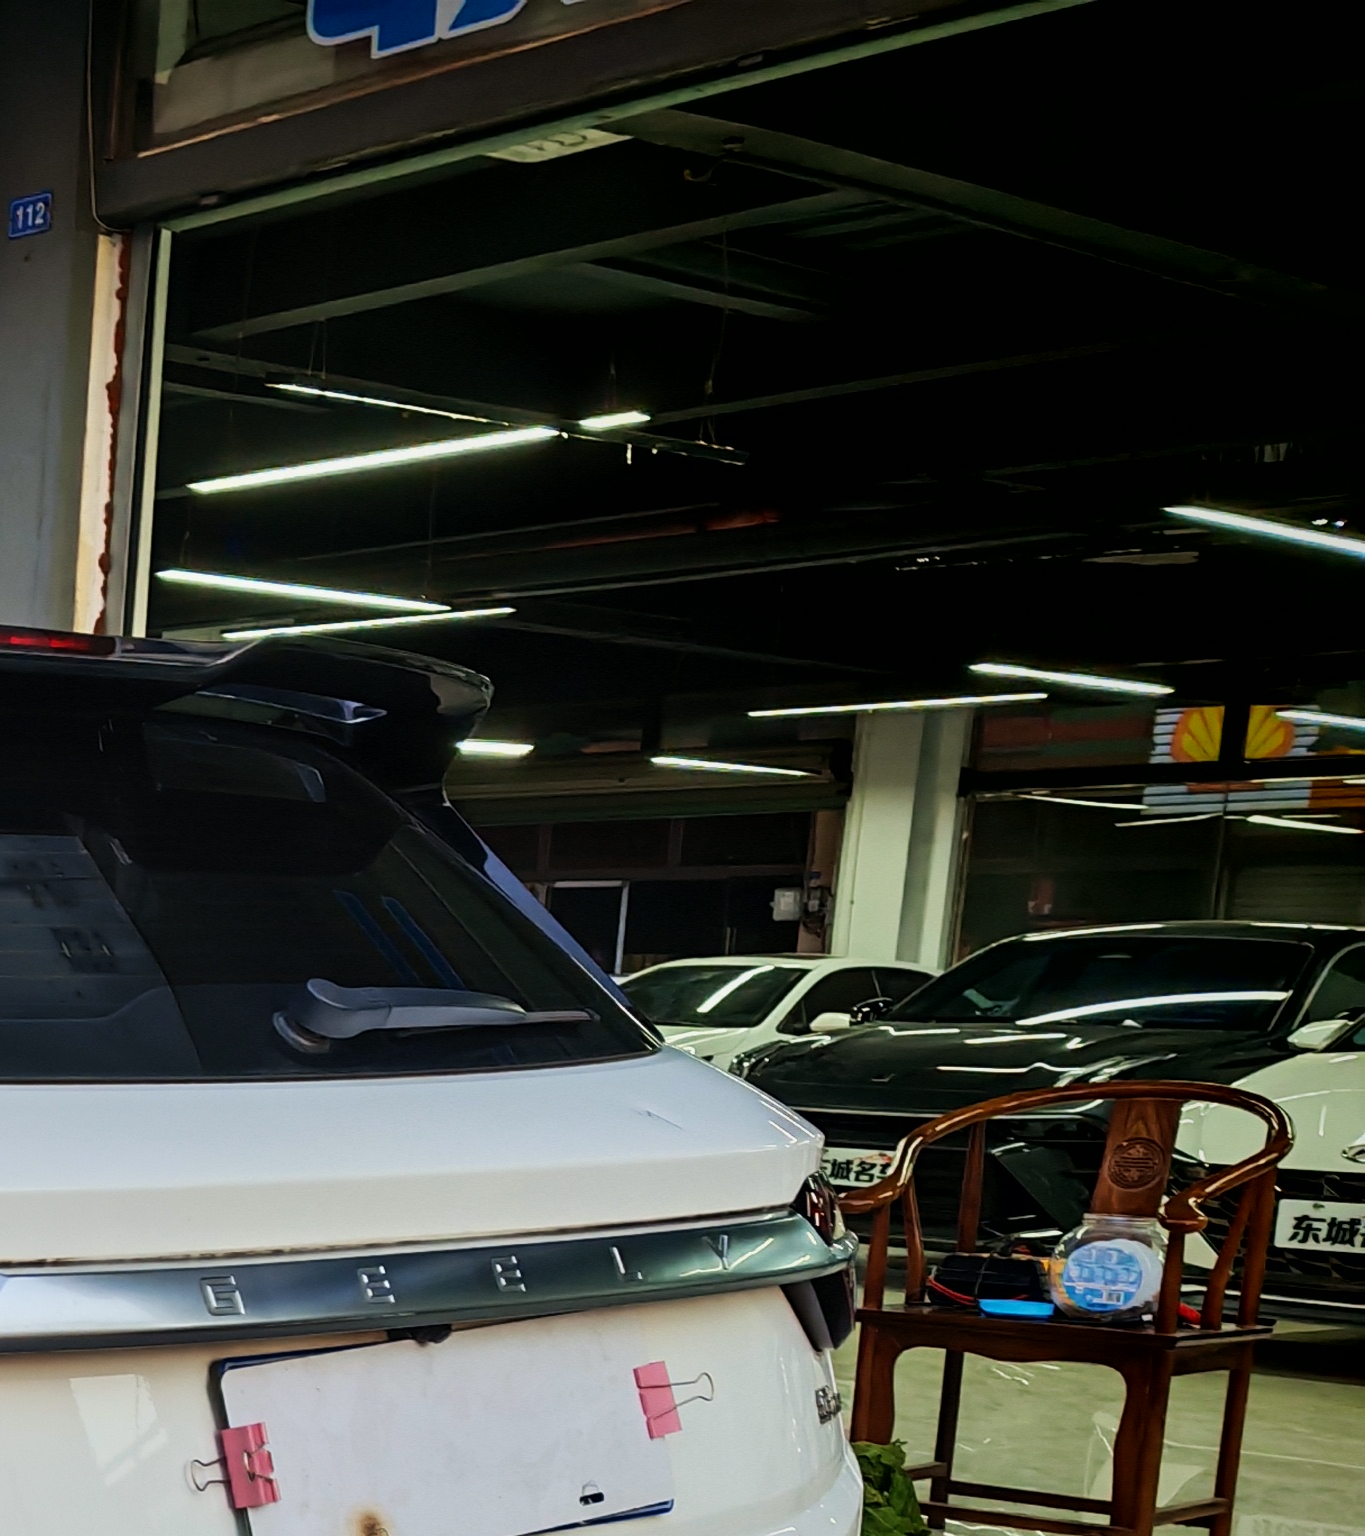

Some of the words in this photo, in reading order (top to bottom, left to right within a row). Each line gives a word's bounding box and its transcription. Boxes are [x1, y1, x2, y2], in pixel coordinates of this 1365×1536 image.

[15, 201, 47, 230] 112
[1288, 1214, 1365, 1249] 东城
[199, 1232, 733, 1318] GEELY
